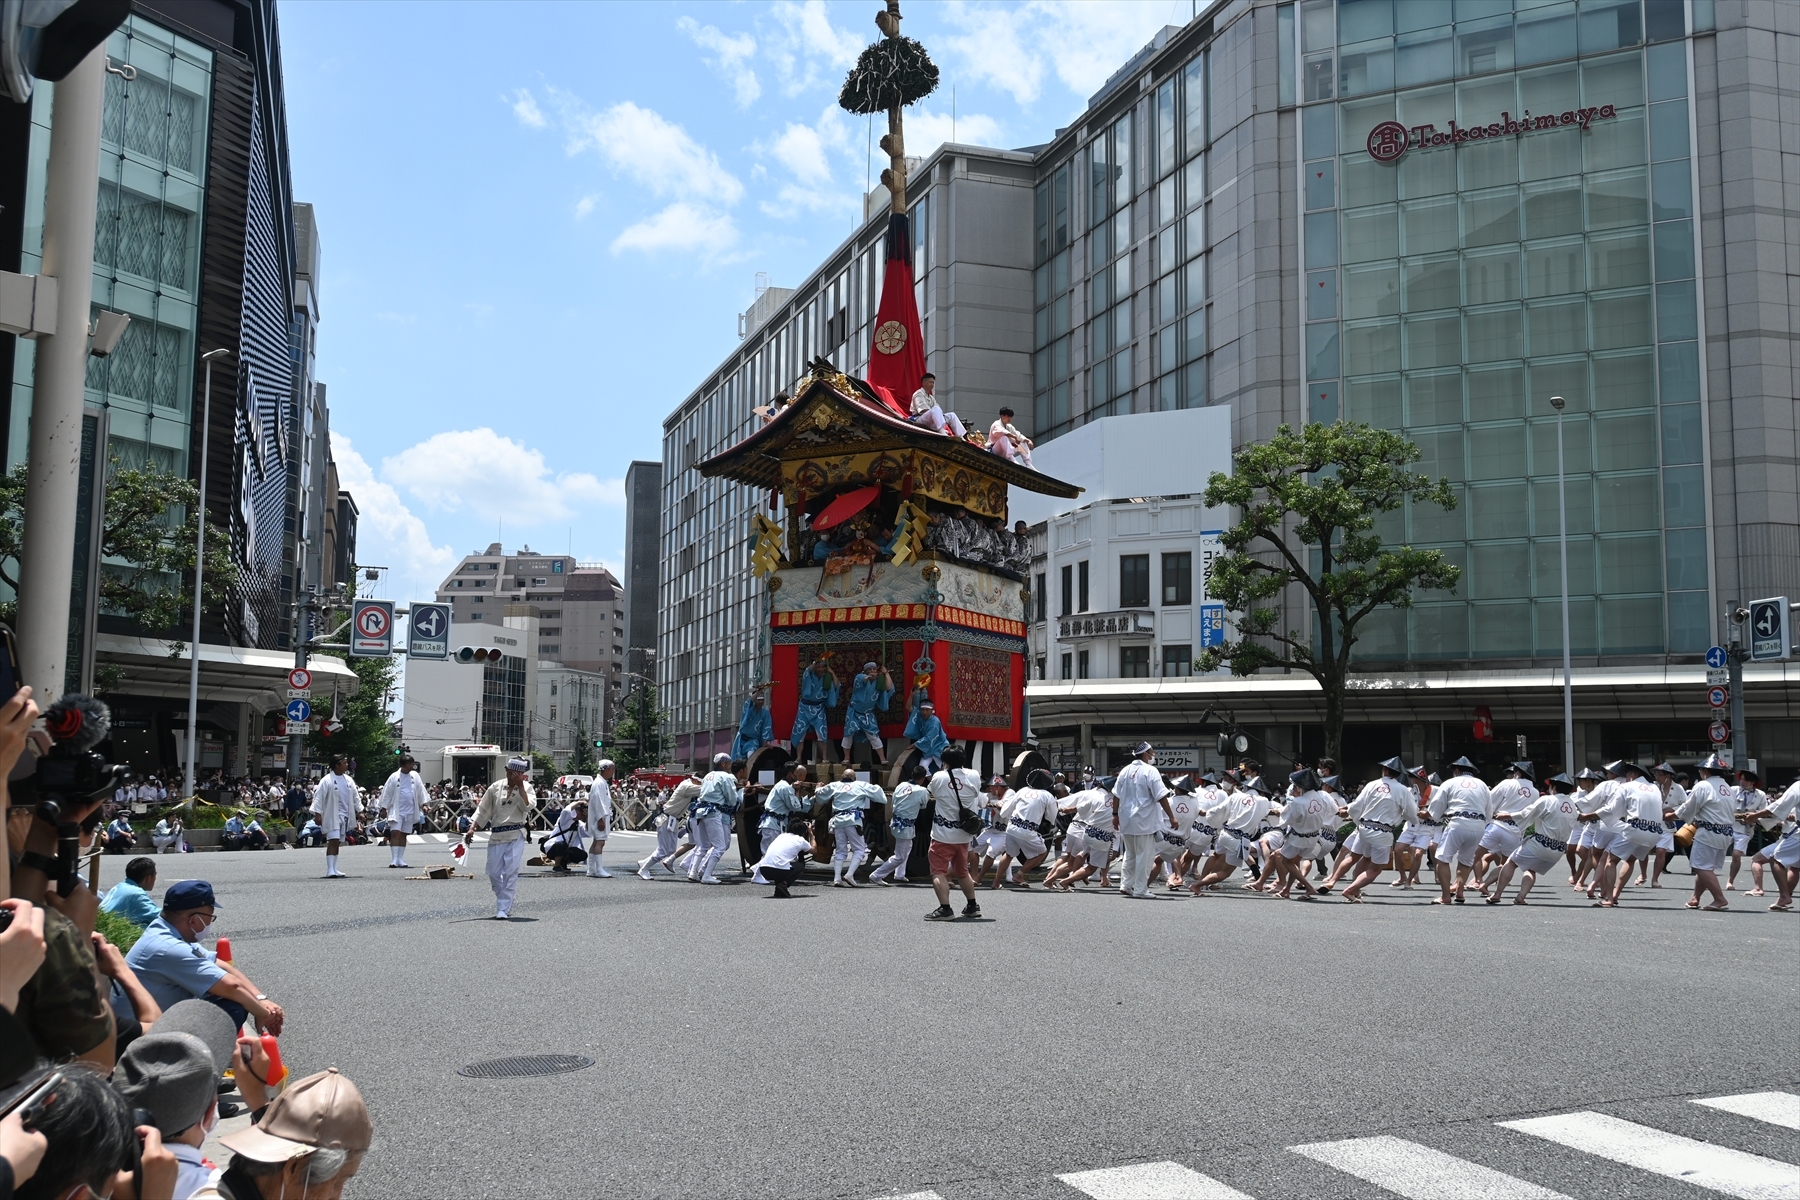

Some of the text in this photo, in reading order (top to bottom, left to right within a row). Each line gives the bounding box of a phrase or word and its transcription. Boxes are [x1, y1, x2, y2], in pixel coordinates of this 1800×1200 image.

[1411, 103, 1617, 149] Takashimaya
[1203, 609, 1211, 646] 買えます
[412, 643, 445, 651] 路線バスを除く
